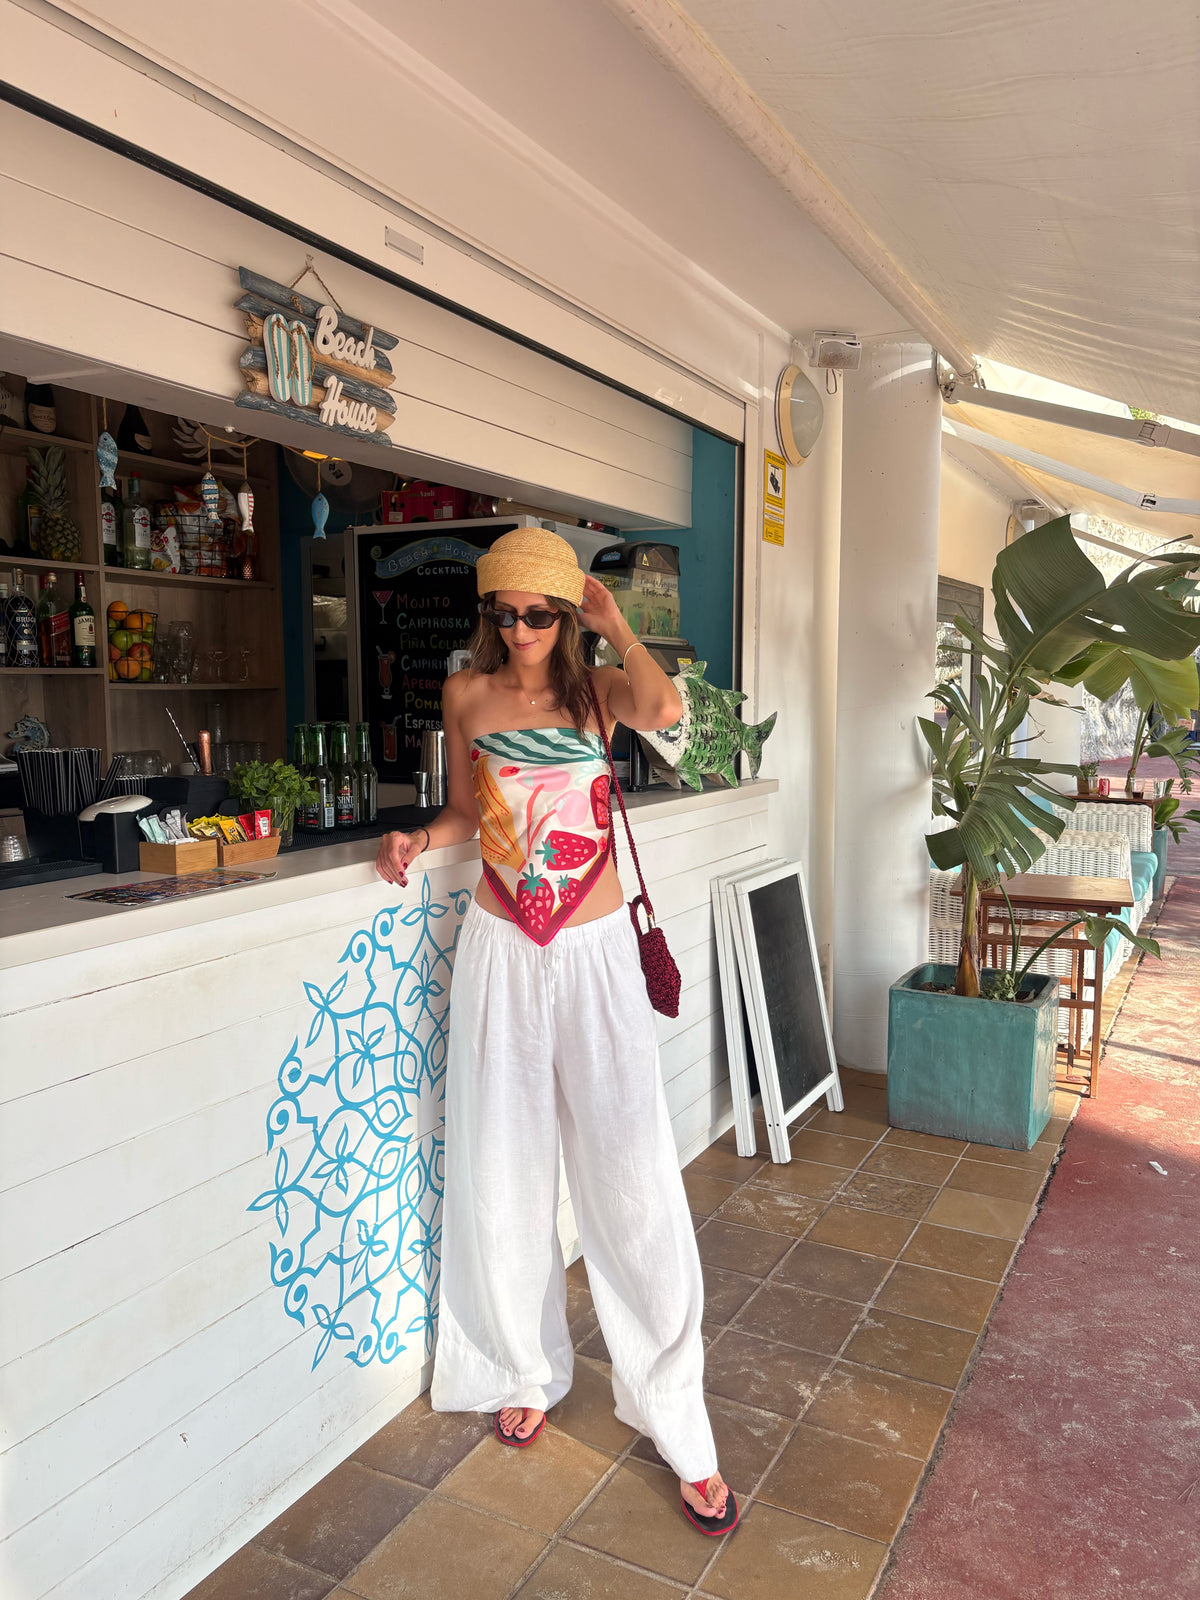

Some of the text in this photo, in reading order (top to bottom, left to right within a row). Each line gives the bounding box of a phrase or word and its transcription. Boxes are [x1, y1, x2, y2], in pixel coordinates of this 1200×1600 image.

[313, 305, 377, 370] Beach
[319, 375, 378, 433] House
[388, 548, 429, 572] BEACH
[416, 565, 470, 576] COCKTAILS
[396, 593, 451, 609] MOJITO
[396, 612, 471, 630] CAIPIROSKA
[429, 634, 469, 650] COLAD
[400, 654, 448, 671] CAIPIRIN
[404, 691, 443, 710] POMA
[404, 734, 422, 749] MA
